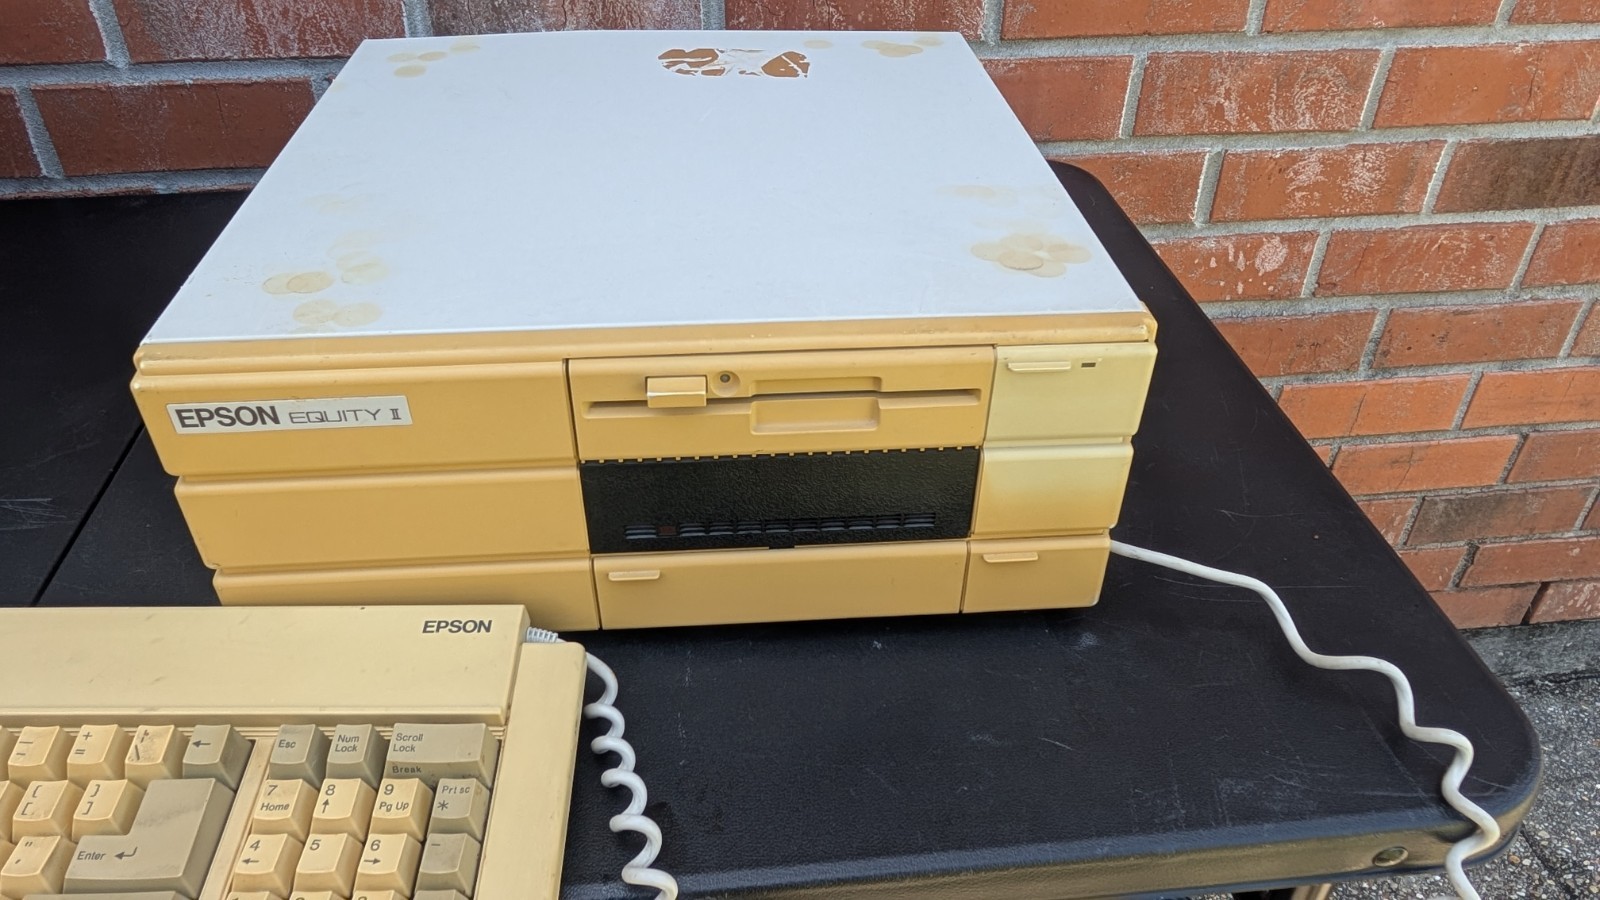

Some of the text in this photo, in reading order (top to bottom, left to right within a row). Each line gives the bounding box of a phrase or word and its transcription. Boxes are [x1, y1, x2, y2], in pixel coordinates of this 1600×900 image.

[175, 405, 281, 428] EPSON
[289, 408, 381, 424] EQUITY
[422, 619, 492, 634] EPSON
[337, 734, 360, 743] Num
[395, 733, 424, 742] Scroll
[278, 739, 296, 749] Esc
[335, 743, 358, 753] Lock
[393, 744, 416, 753] Lock
[392, 765, 422, 774] Break
[267, 784, 278, 796] 7
[325, 784, 336, 796] 8
[384, 784, 394, 796] 9
[441, 785, 470, 794] Prt sc
[260, 802, 290, 812] Home
[379, 801, 409, 812] Pg Up
[250, 839, 261, 851] 4
[309, 839, 322, 851] 5
[370, 839, 381, 851] 6
[77, 850, 106, 861] Enter
